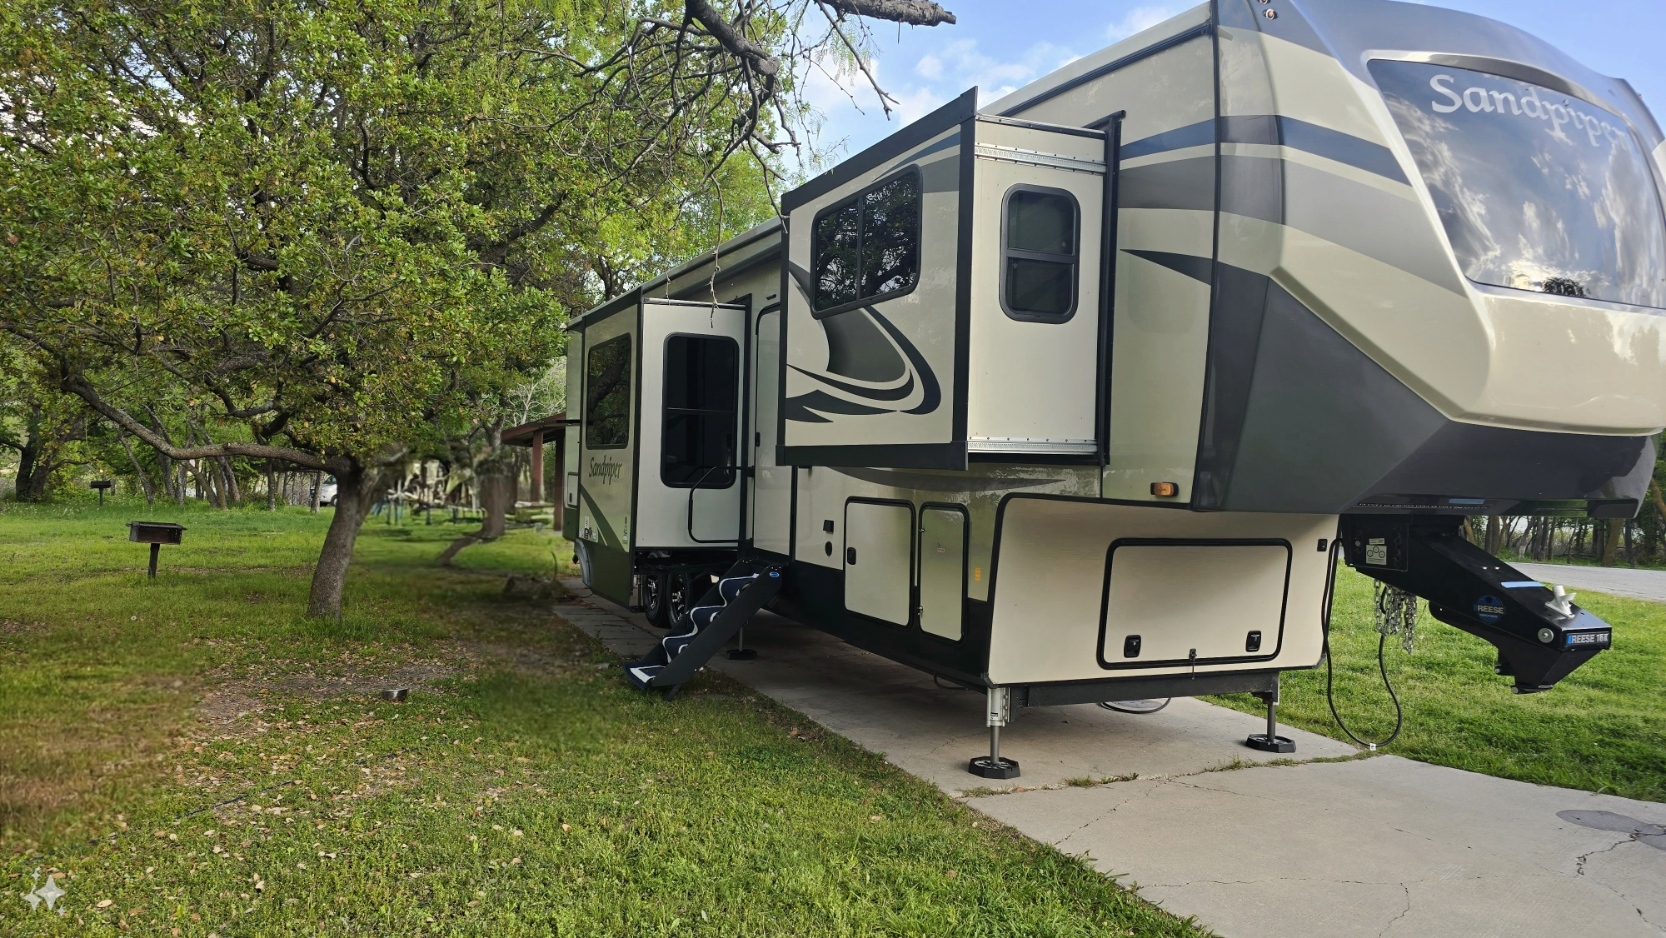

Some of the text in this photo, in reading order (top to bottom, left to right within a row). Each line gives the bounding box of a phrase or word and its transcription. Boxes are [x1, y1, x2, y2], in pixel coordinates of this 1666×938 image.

[1429, 74, 1625, 147] Sandpiper
[589, 455, 622, 485] Sandpiper
[1477, 604, 1504, 614] REESE
[1572, 634, 1595, 644] REESE
